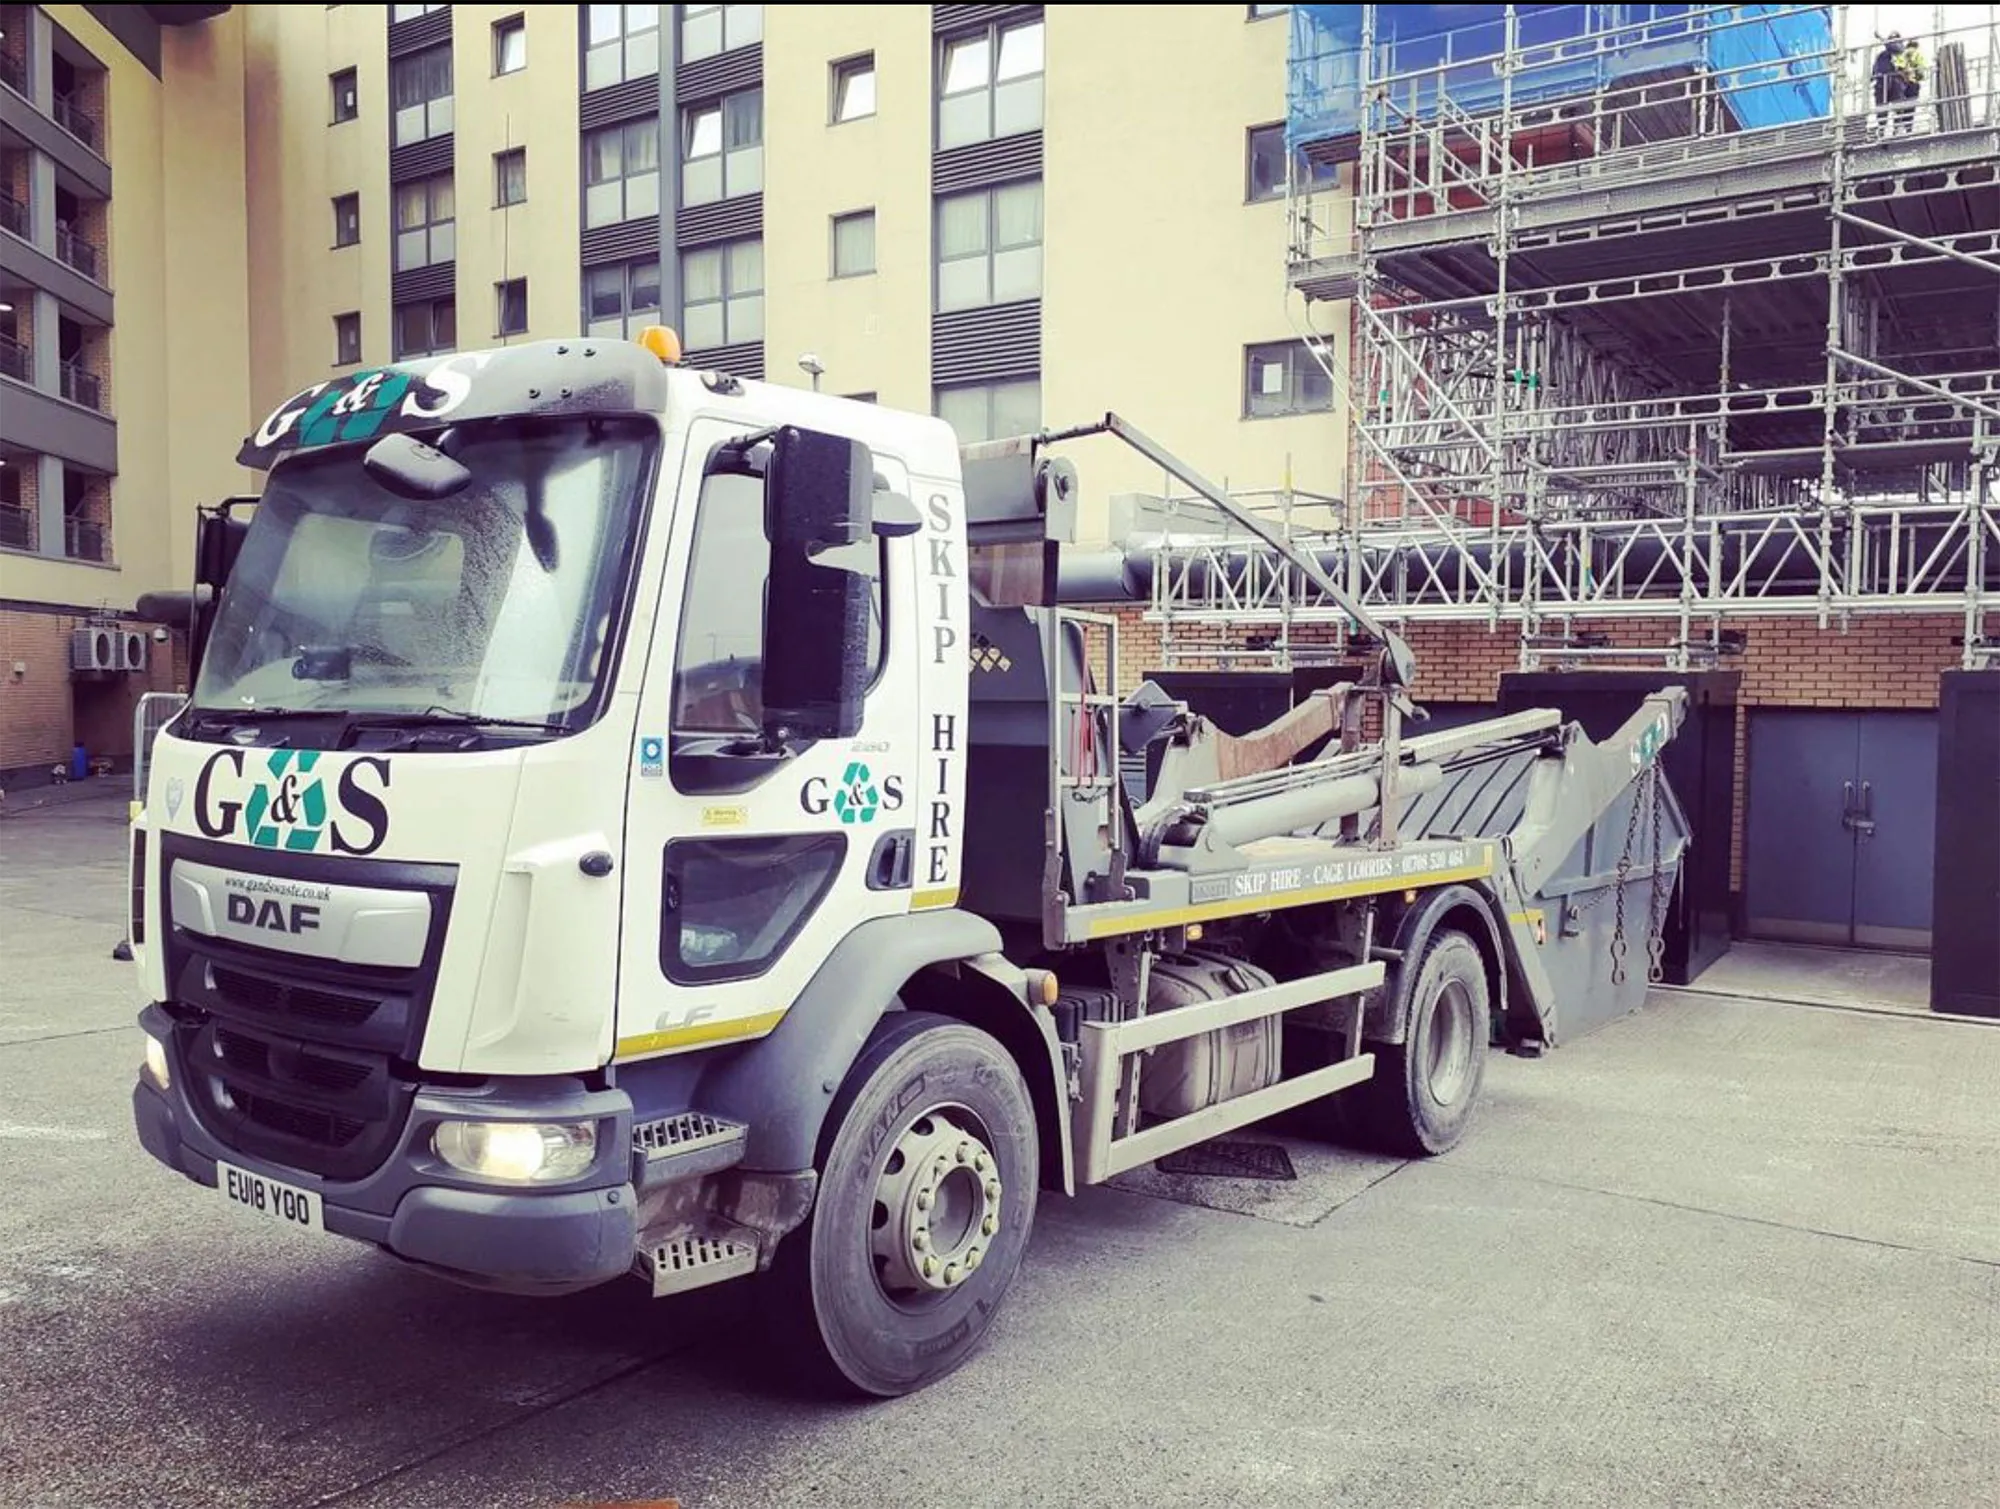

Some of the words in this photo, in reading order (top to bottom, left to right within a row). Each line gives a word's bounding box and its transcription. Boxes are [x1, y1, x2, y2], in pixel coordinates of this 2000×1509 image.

[928, 493, 956, 664] SKIP
[194, 748, 391, 856] G&S
[800, 775, 903, 815] G&S
[930, 714, 956, 884] HIRE
[1235, 872, 1266, 896] SKIP
[1270, 867, 1301, 892] HIRE
[1313, 863, 1345, 885] CAGE
[1348, 857, 1392, 880] LORRIES
[228, 893, 321, 934] DAF
[655, 1004, 717, 1031] LF
[228, 1168, 265, 1210] EU18
